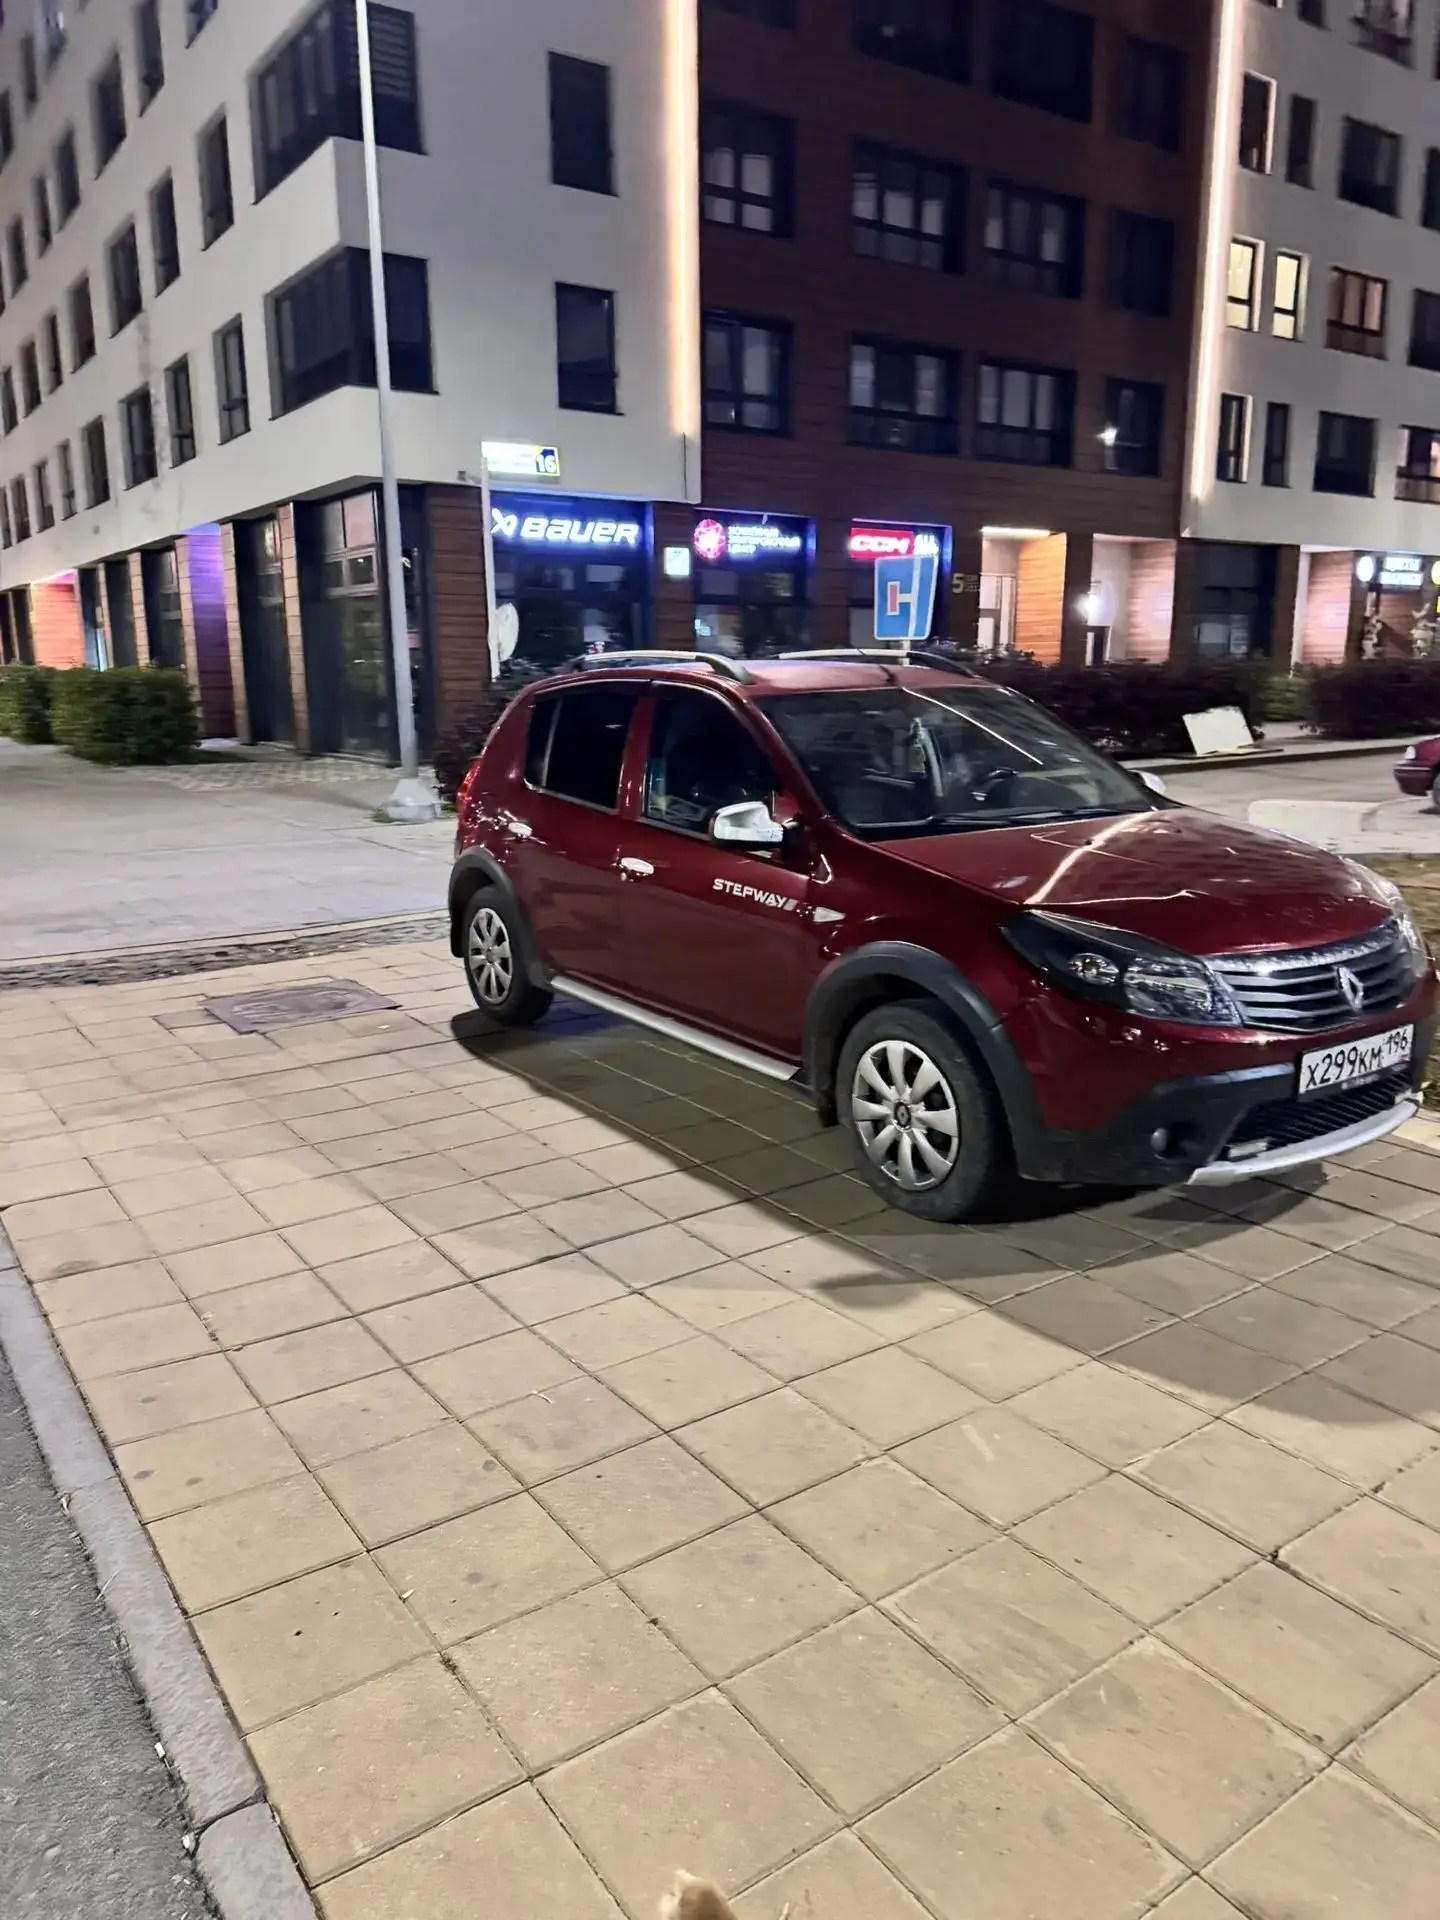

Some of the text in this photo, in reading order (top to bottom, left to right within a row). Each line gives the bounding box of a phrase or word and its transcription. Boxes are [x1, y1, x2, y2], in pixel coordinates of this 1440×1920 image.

[536, 454, 557, 473] 16
[952, 572, 965, 594] 5
[712, 878, 787, 908] STEPWAY
[1386, 1028, 1408, 1055] 196
